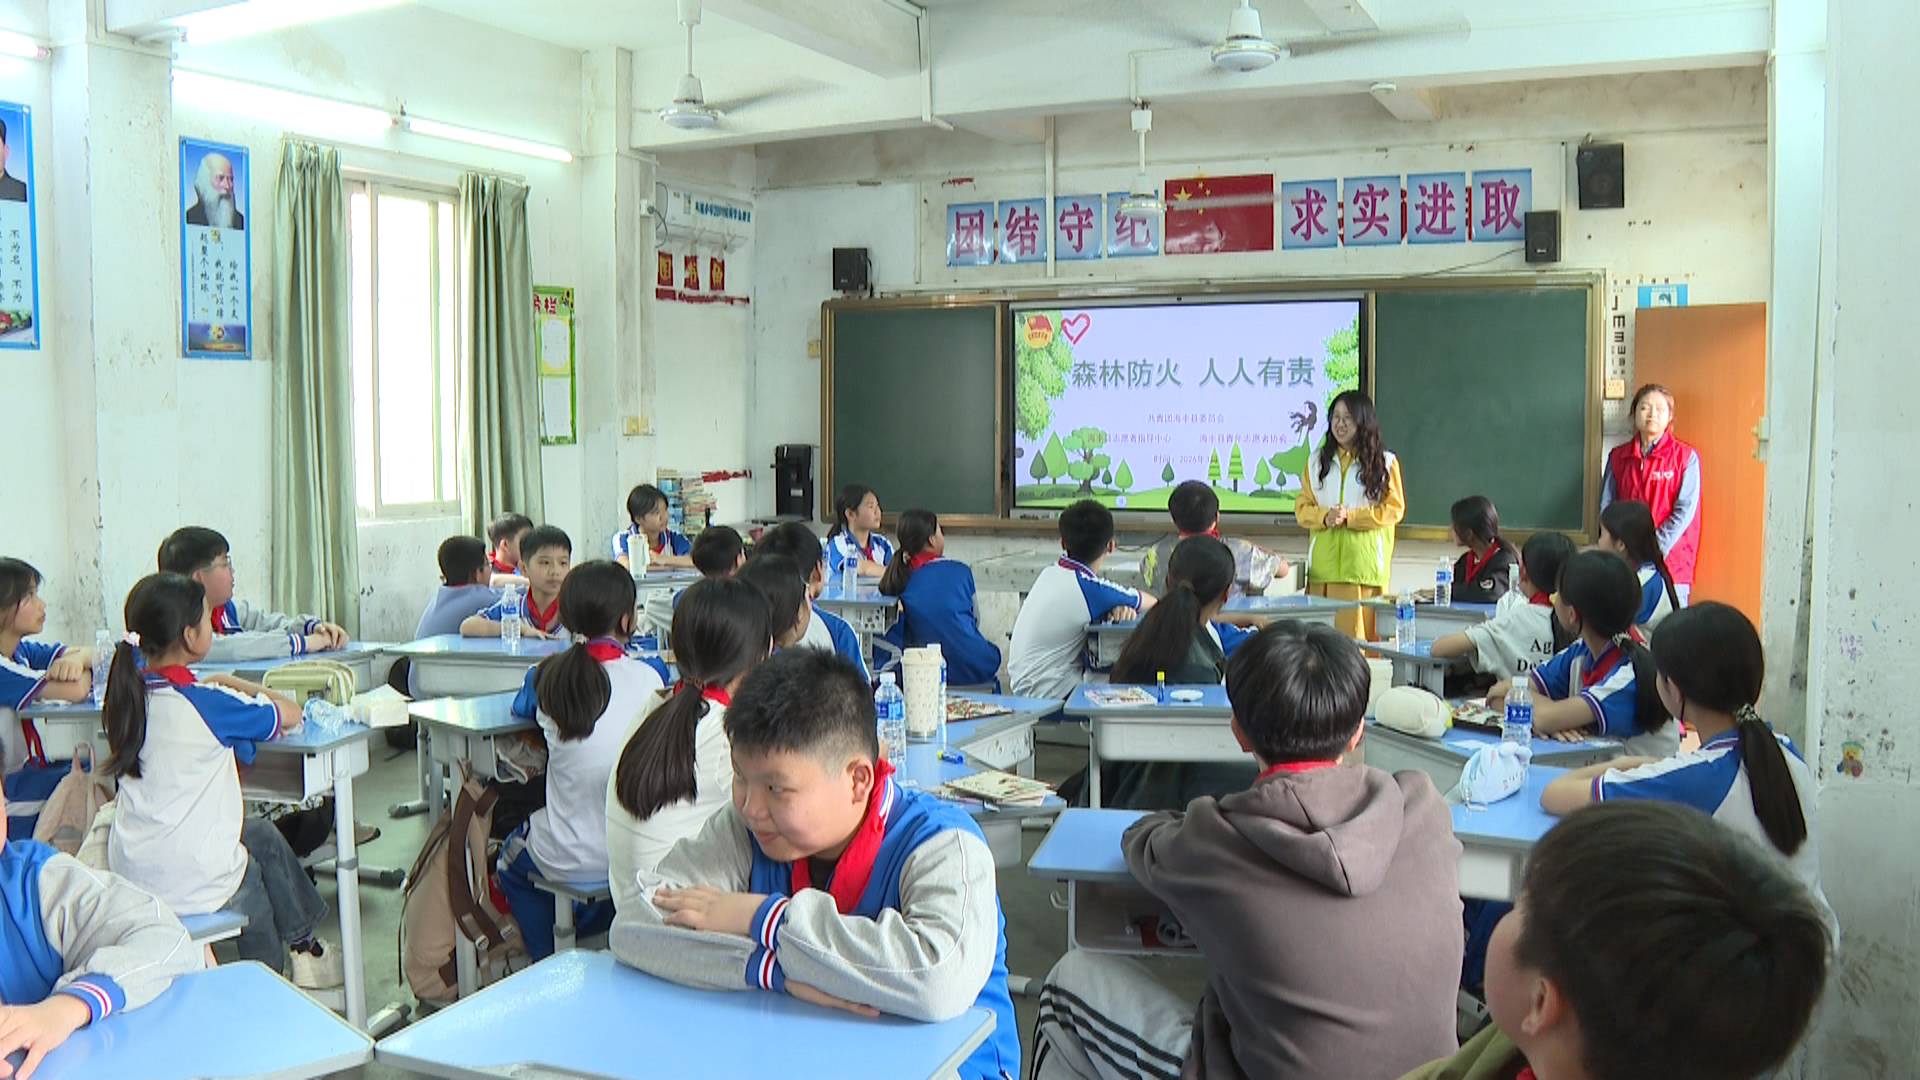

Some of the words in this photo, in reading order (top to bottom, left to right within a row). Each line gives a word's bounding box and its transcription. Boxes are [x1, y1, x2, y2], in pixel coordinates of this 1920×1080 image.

[955, 202, 1151, 258] 团结守纪
[1290, 180, 1522, 240] 求实进取
[1072, 358, 1182, 388] 森林防火
[1199, 356, 1316, 387] 人人有责
